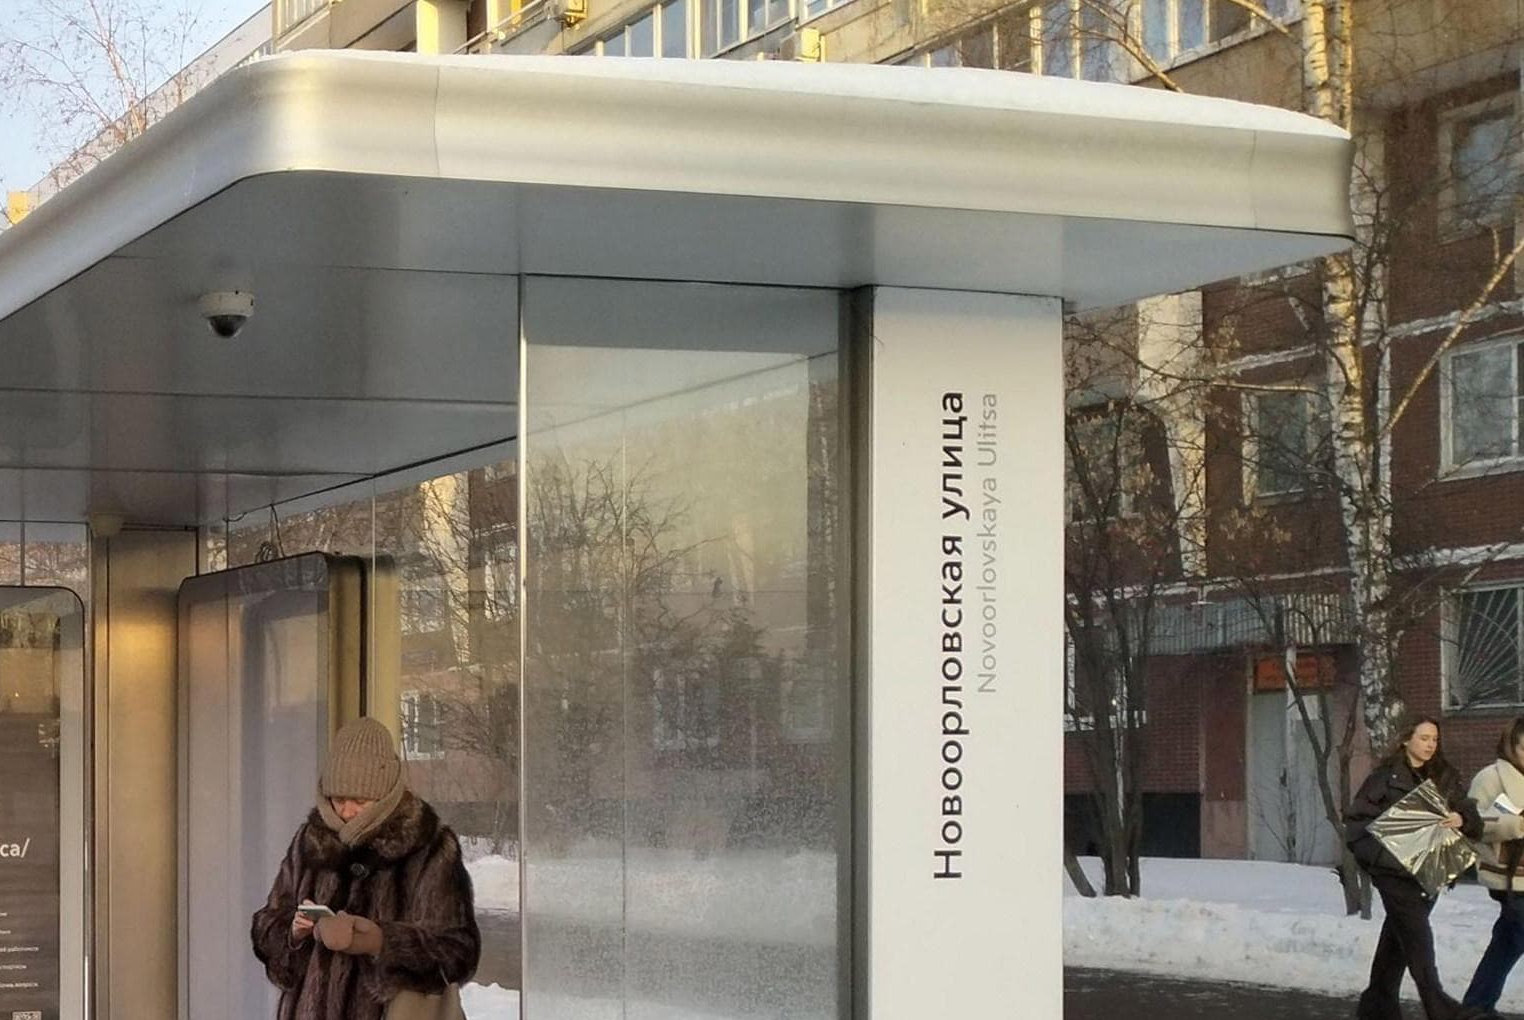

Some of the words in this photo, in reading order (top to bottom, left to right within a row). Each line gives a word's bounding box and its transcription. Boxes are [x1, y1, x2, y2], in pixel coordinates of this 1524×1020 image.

[942, 392, 970, 521] улица
[977, 393, 997, 466] Ulitsa
[976, 478, 1001, 693] Novoorlovskaya
[934, 534, 970, 879] Новоорловская
